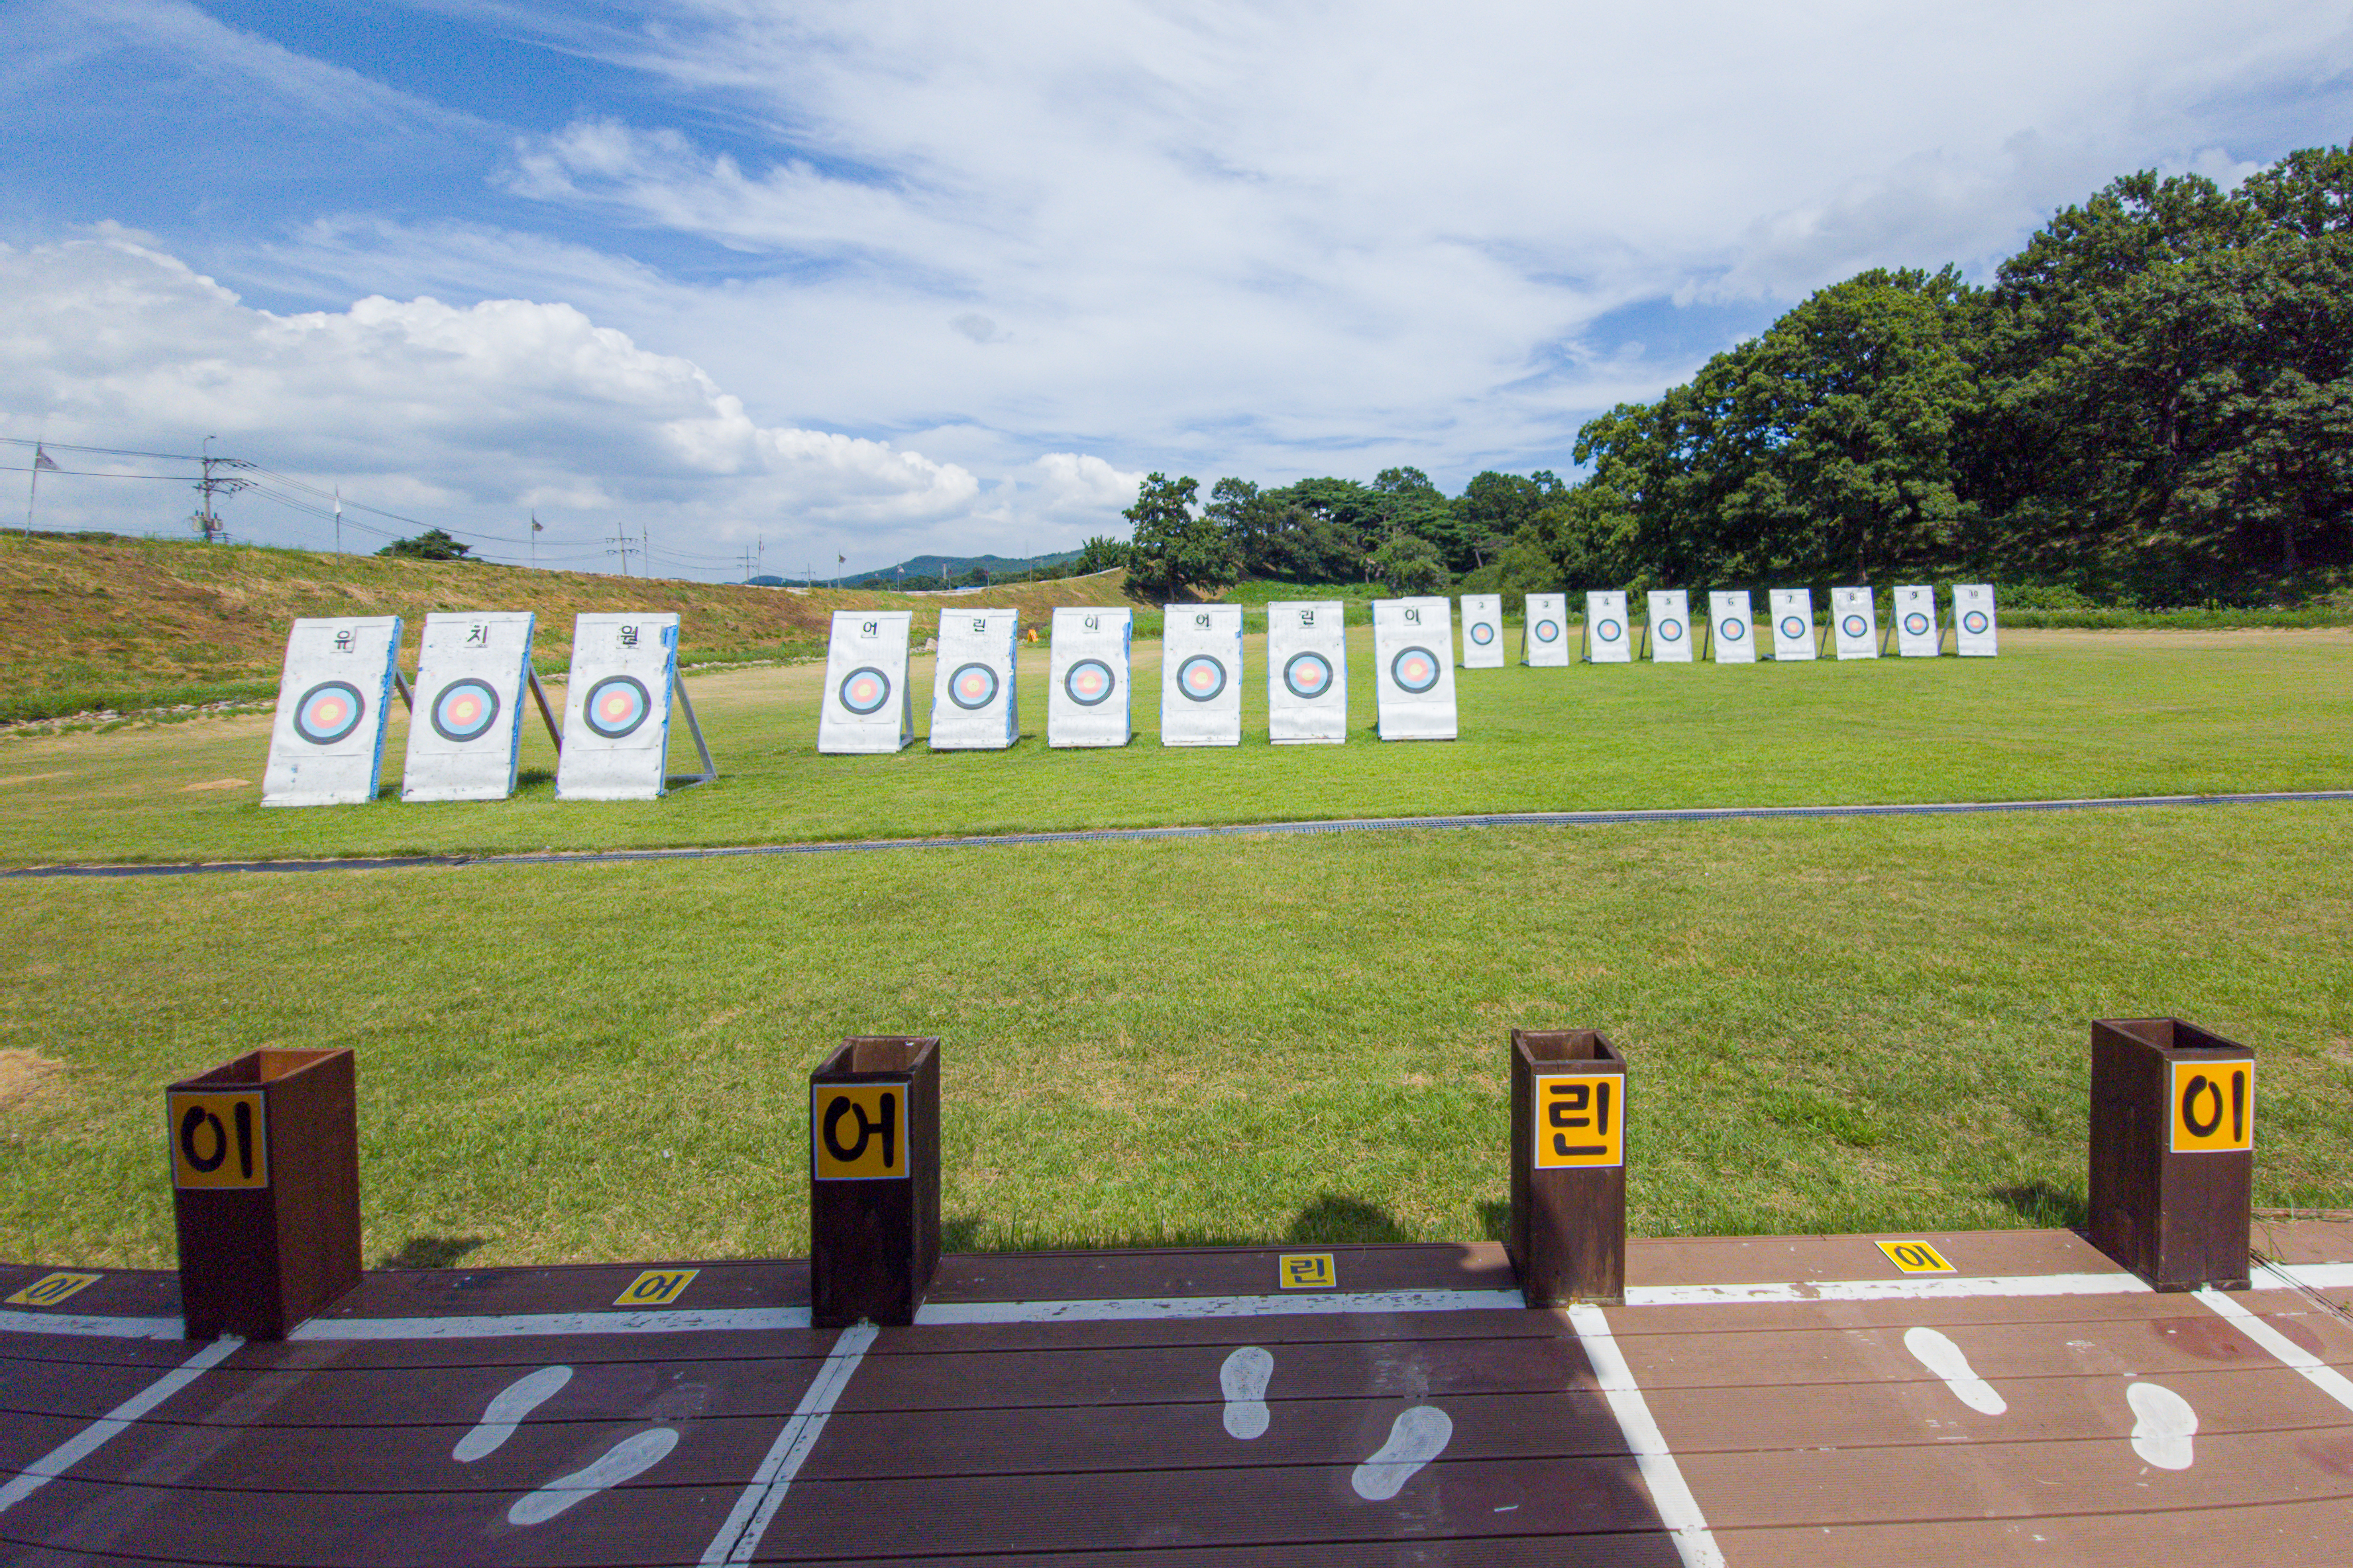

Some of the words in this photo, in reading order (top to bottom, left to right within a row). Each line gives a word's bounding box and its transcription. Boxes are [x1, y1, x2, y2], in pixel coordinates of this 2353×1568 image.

[1849, 592, 1855, 601] 8
[973, 618, 986, 632] 린
[1085, 616, 1098, 630] 이
[1196, 614, 1209, 627] 어
[1301, 610, 1314, 625] 린
[1405, 609, 1419, 623] 이
[466, 625, 488, 644] 치
[863, 621, 877, 635] 어
[334, 630, 351, 649] 유
[2182, 1070, 2245, 1143] 이
[1549, 1081, 1610, 1156] 린
[180, 1101, 252, 1179] 이
[823, 1092, 895, 1169] 어
[1289, 1258, 1327, 1284] 린
[633, 1274, 686, 1300] 어
